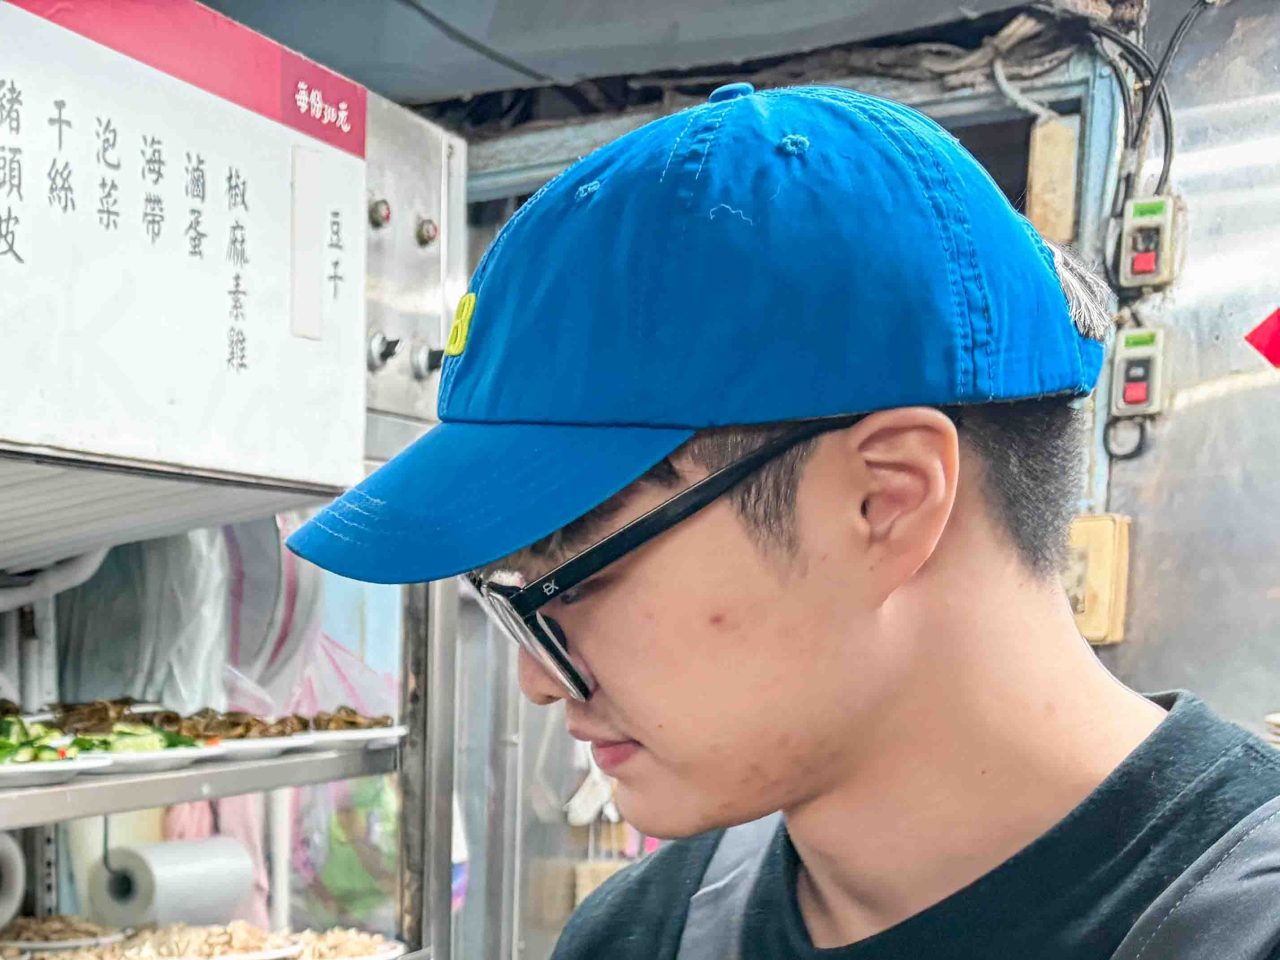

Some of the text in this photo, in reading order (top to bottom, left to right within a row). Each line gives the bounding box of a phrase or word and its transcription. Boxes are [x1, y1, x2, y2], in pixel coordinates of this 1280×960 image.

[46, 99, 76, 214] 干絲
[95, 116, 122, 231] 泡菜
[140, 134, 166, 244] 海帶
[184, 151, 209, 260] 滷蛋
[327, 210, 345, 299] 豆干
